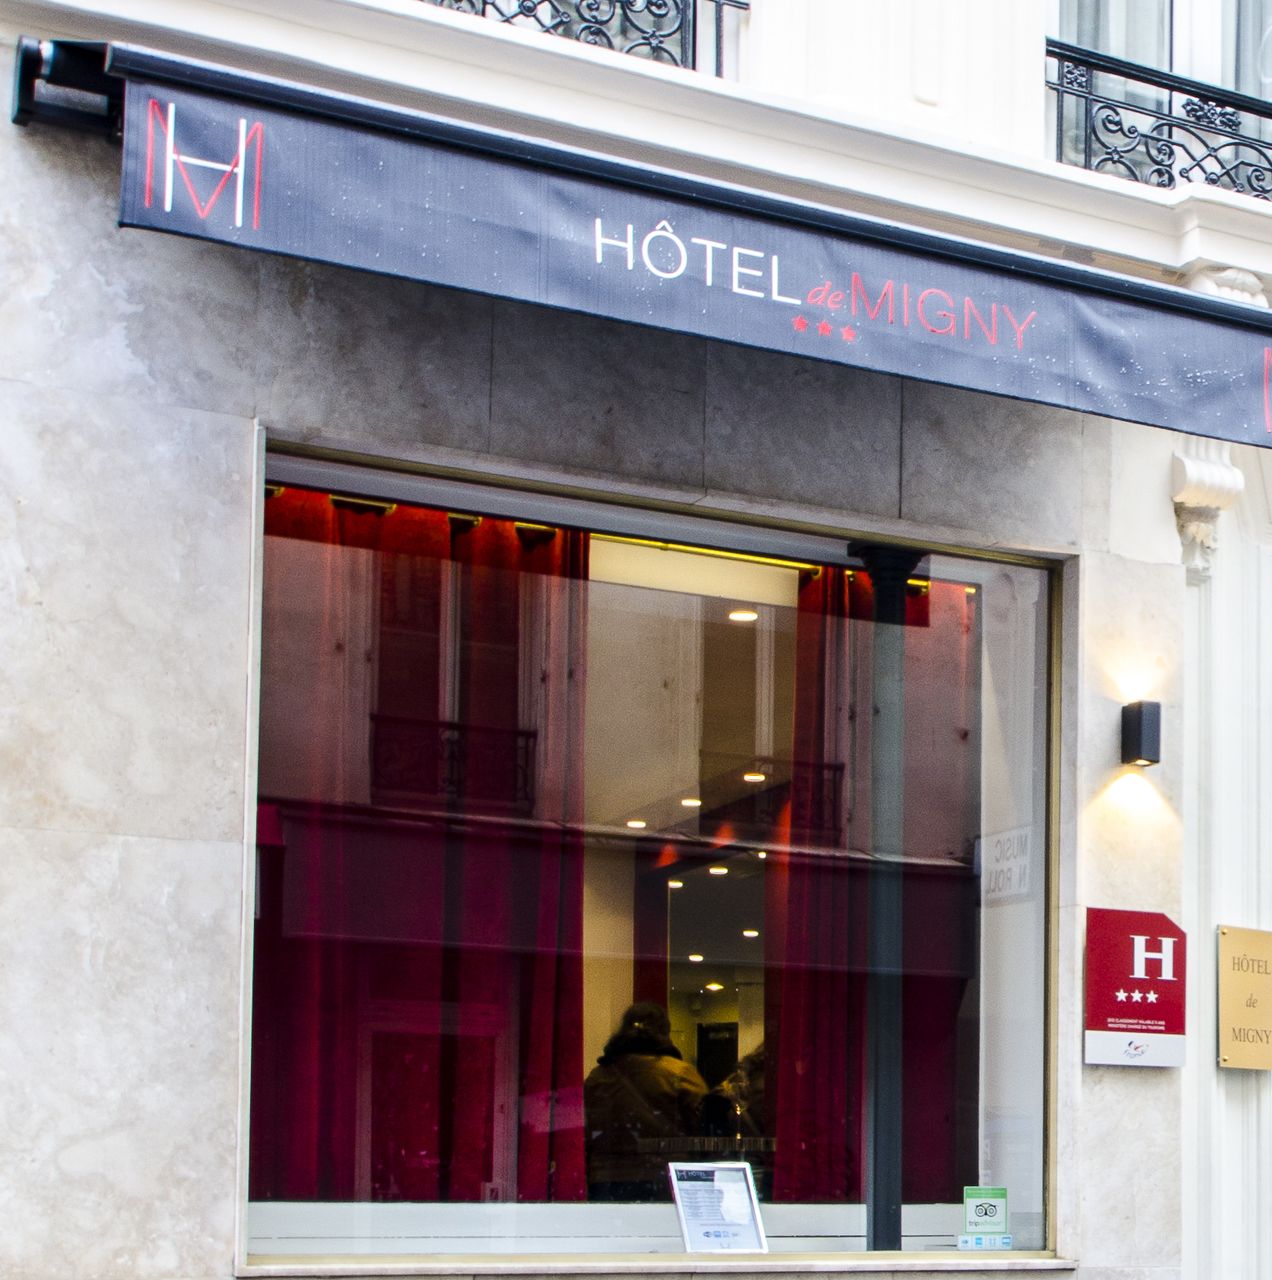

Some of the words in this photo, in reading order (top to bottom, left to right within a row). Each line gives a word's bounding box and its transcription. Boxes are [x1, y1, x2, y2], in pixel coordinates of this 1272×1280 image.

[595, 218, 802, 305] HÔTEL
[807, 281, 843, 310] de
[850, 272, 1037, 351] MIGNY
[1129, 934, 1178, 981] H
[1232, 953, 1272, 975] HÔTEL
[1245, 993, 1258, 1008] de
[1232, 1027, 1272, 1045] MIGNY
